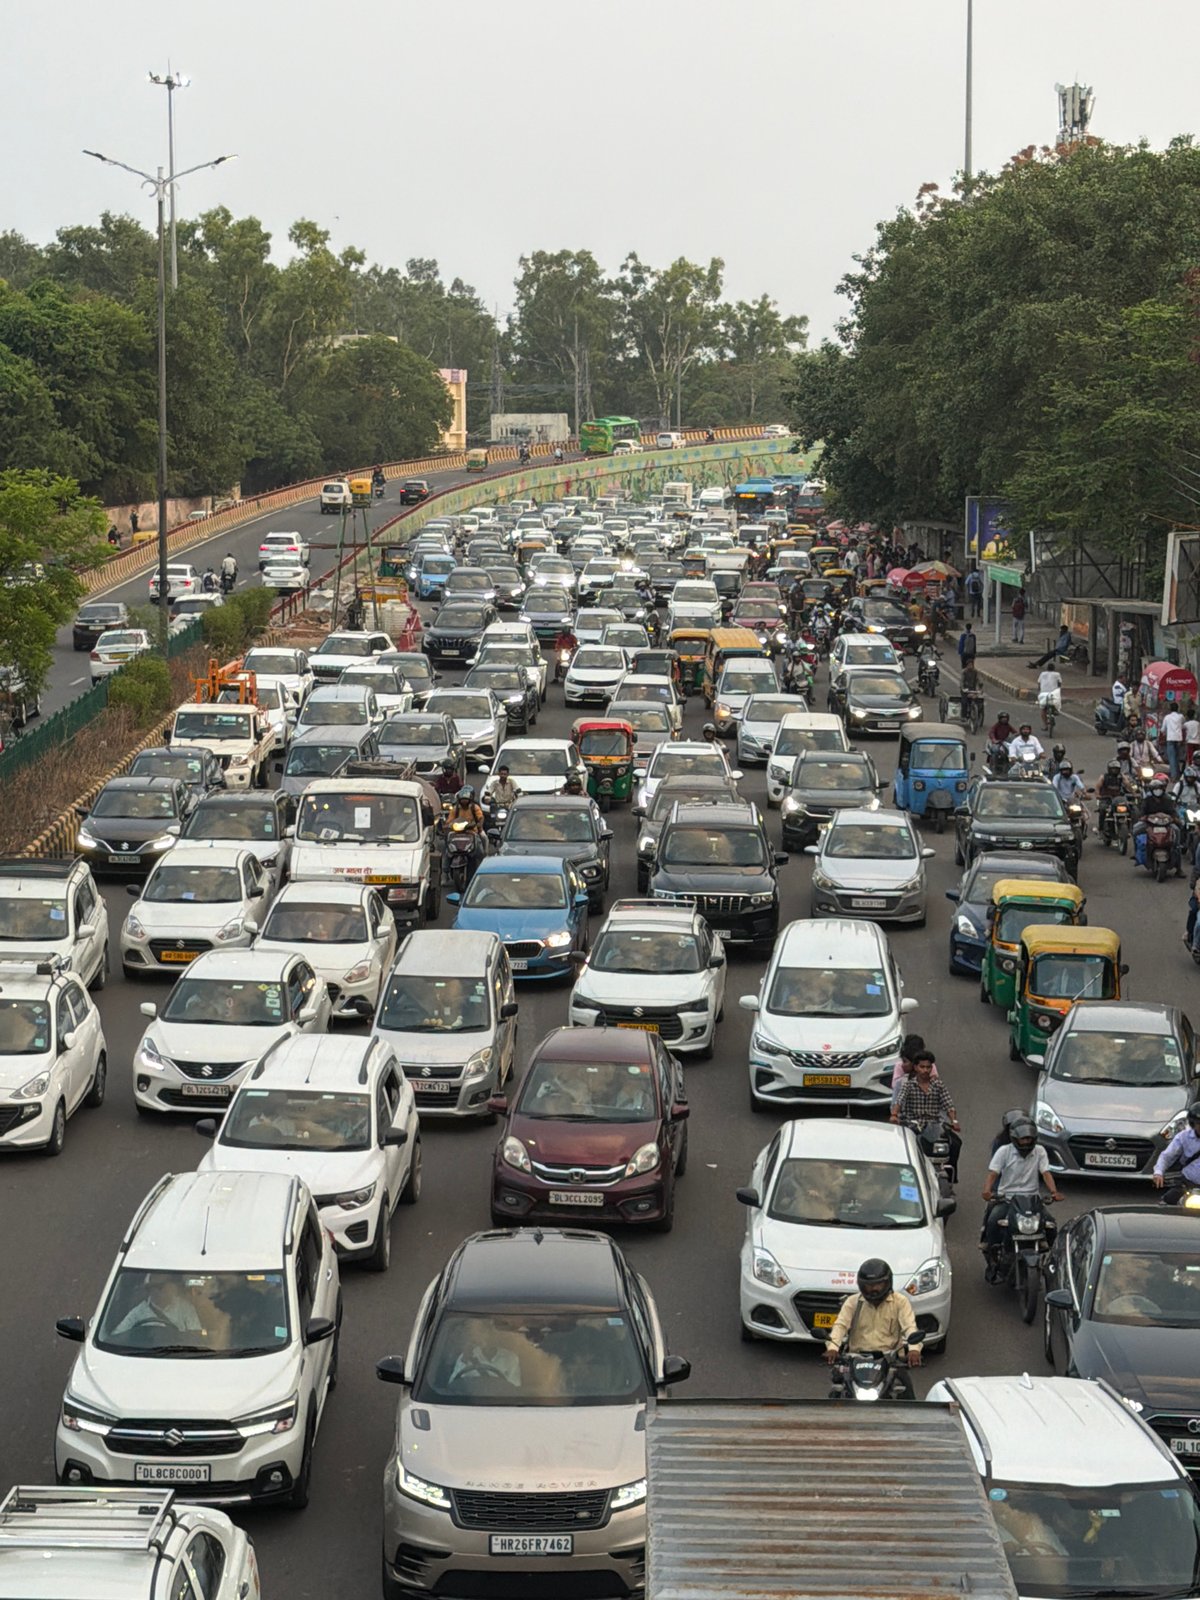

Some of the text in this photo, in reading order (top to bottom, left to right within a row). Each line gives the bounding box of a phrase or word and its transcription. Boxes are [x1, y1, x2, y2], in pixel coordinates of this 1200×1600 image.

[143, 1467, 208, 1479] DL8CBC0001
[465, 1481, 599, 1490] RANGE ROVER
[500, 1538, 570, 1551] HR26FR7462
